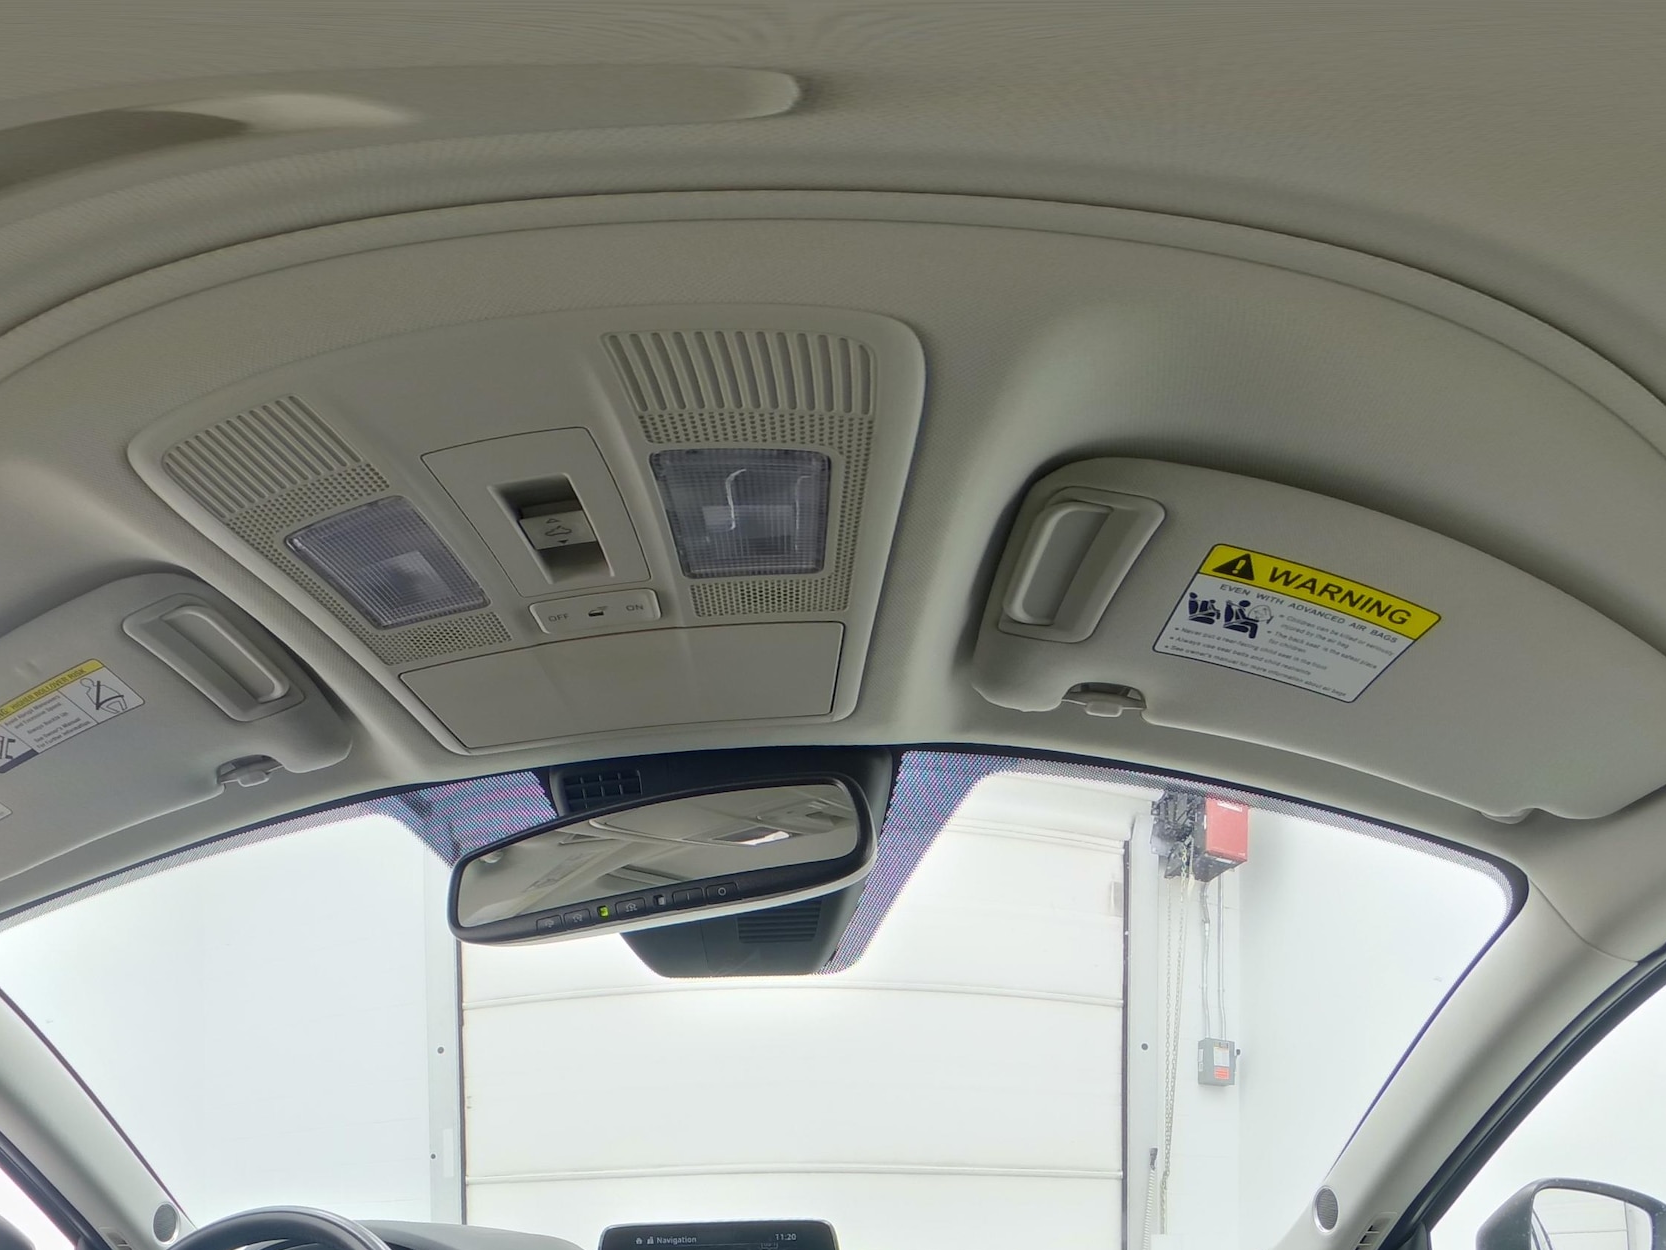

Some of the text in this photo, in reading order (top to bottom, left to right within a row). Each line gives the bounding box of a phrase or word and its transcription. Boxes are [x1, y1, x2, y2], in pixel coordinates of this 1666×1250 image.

[1268, 566, 1411, 625] WARNING
[548, 604, 644, 622] OFF ON
[1220, 584, 1398, 643] EVEN WITH ADVANCED AIR BAGS
[68, 668, 87, 680] RISK
[657, 1236, 697, 1245] Navigation
[775, 1233, 797, 1241] 11:20
